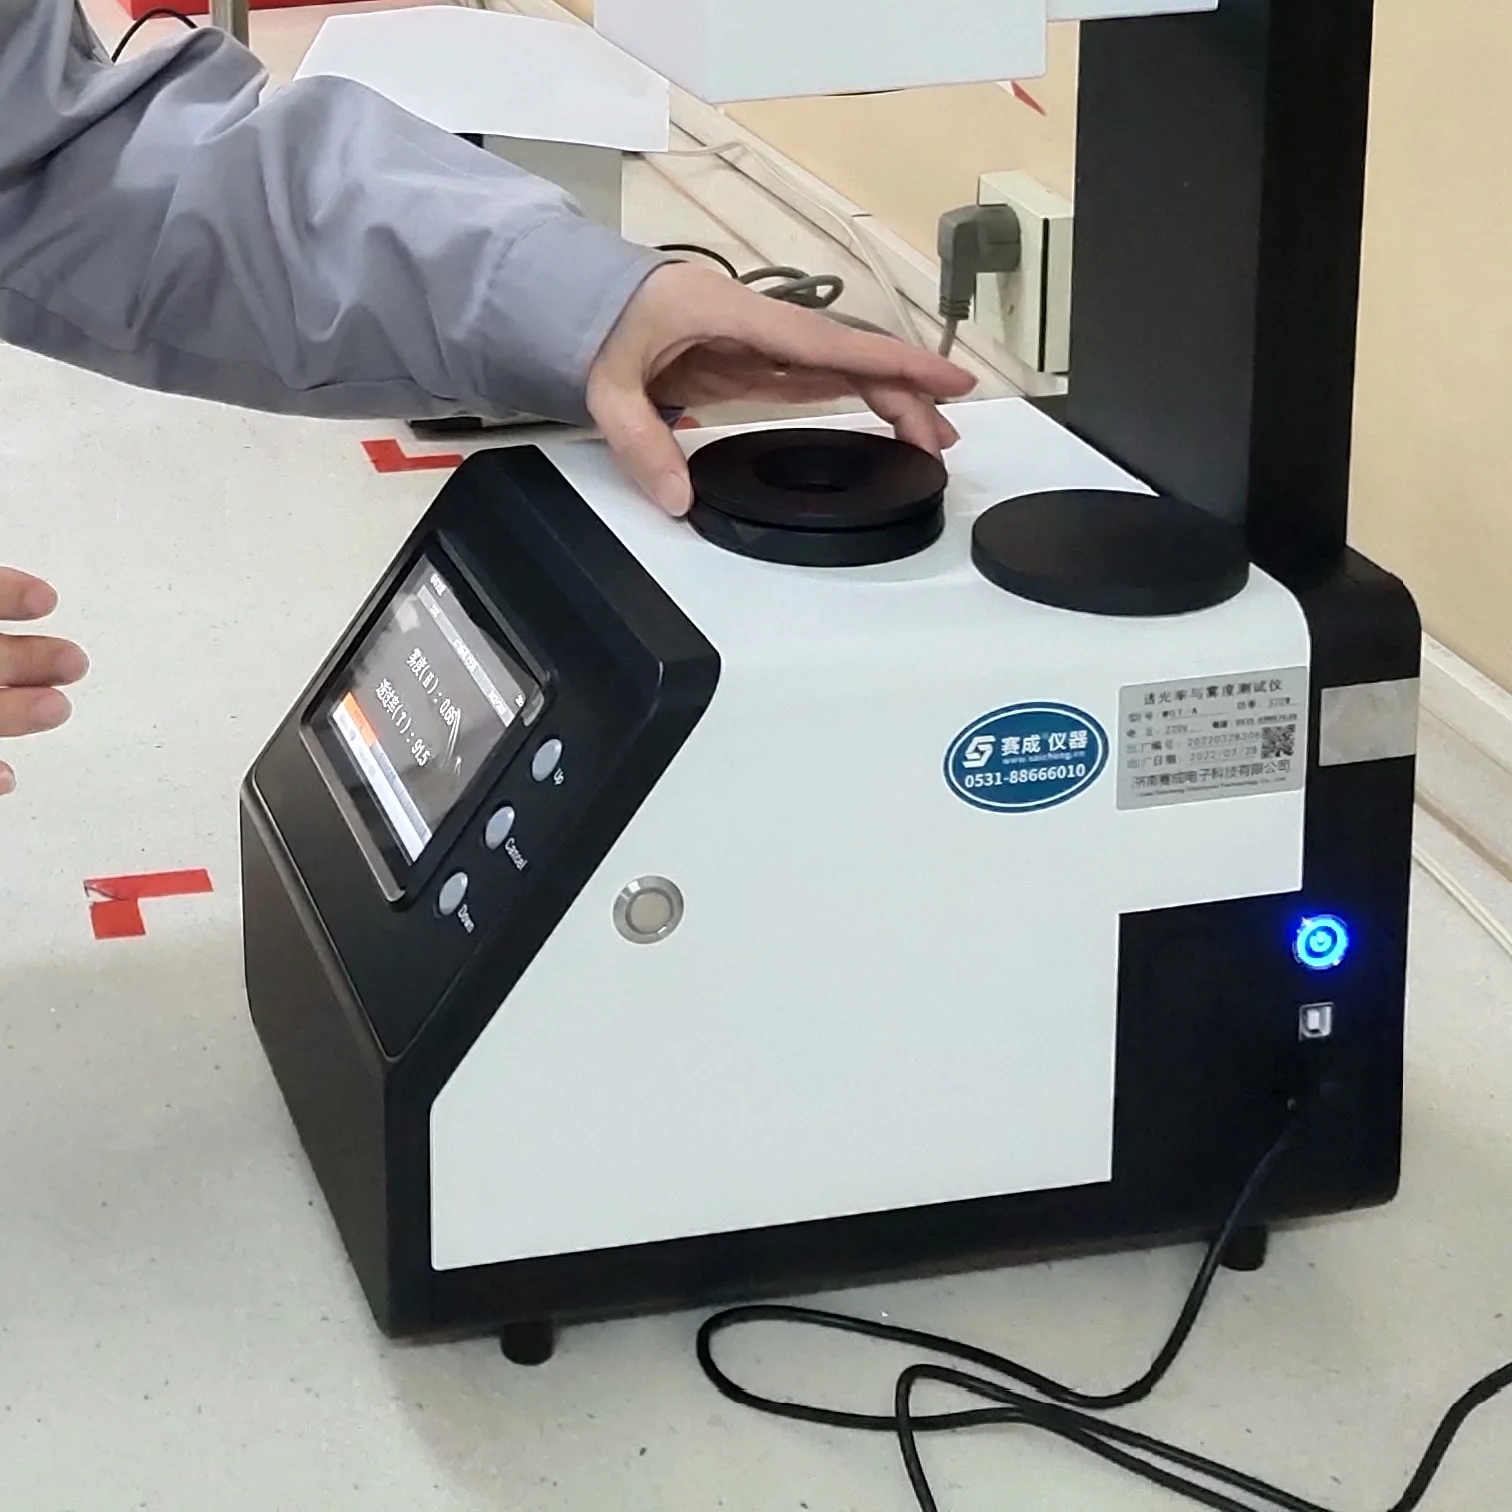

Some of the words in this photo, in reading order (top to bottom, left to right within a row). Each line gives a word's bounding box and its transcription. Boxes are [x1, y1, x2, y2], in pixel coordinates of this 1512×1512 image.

[552, 768, 564, 786] Up
[965, 763, 1086, 789] 0531-88666010
[505, 837, 528, 871] Cancel
